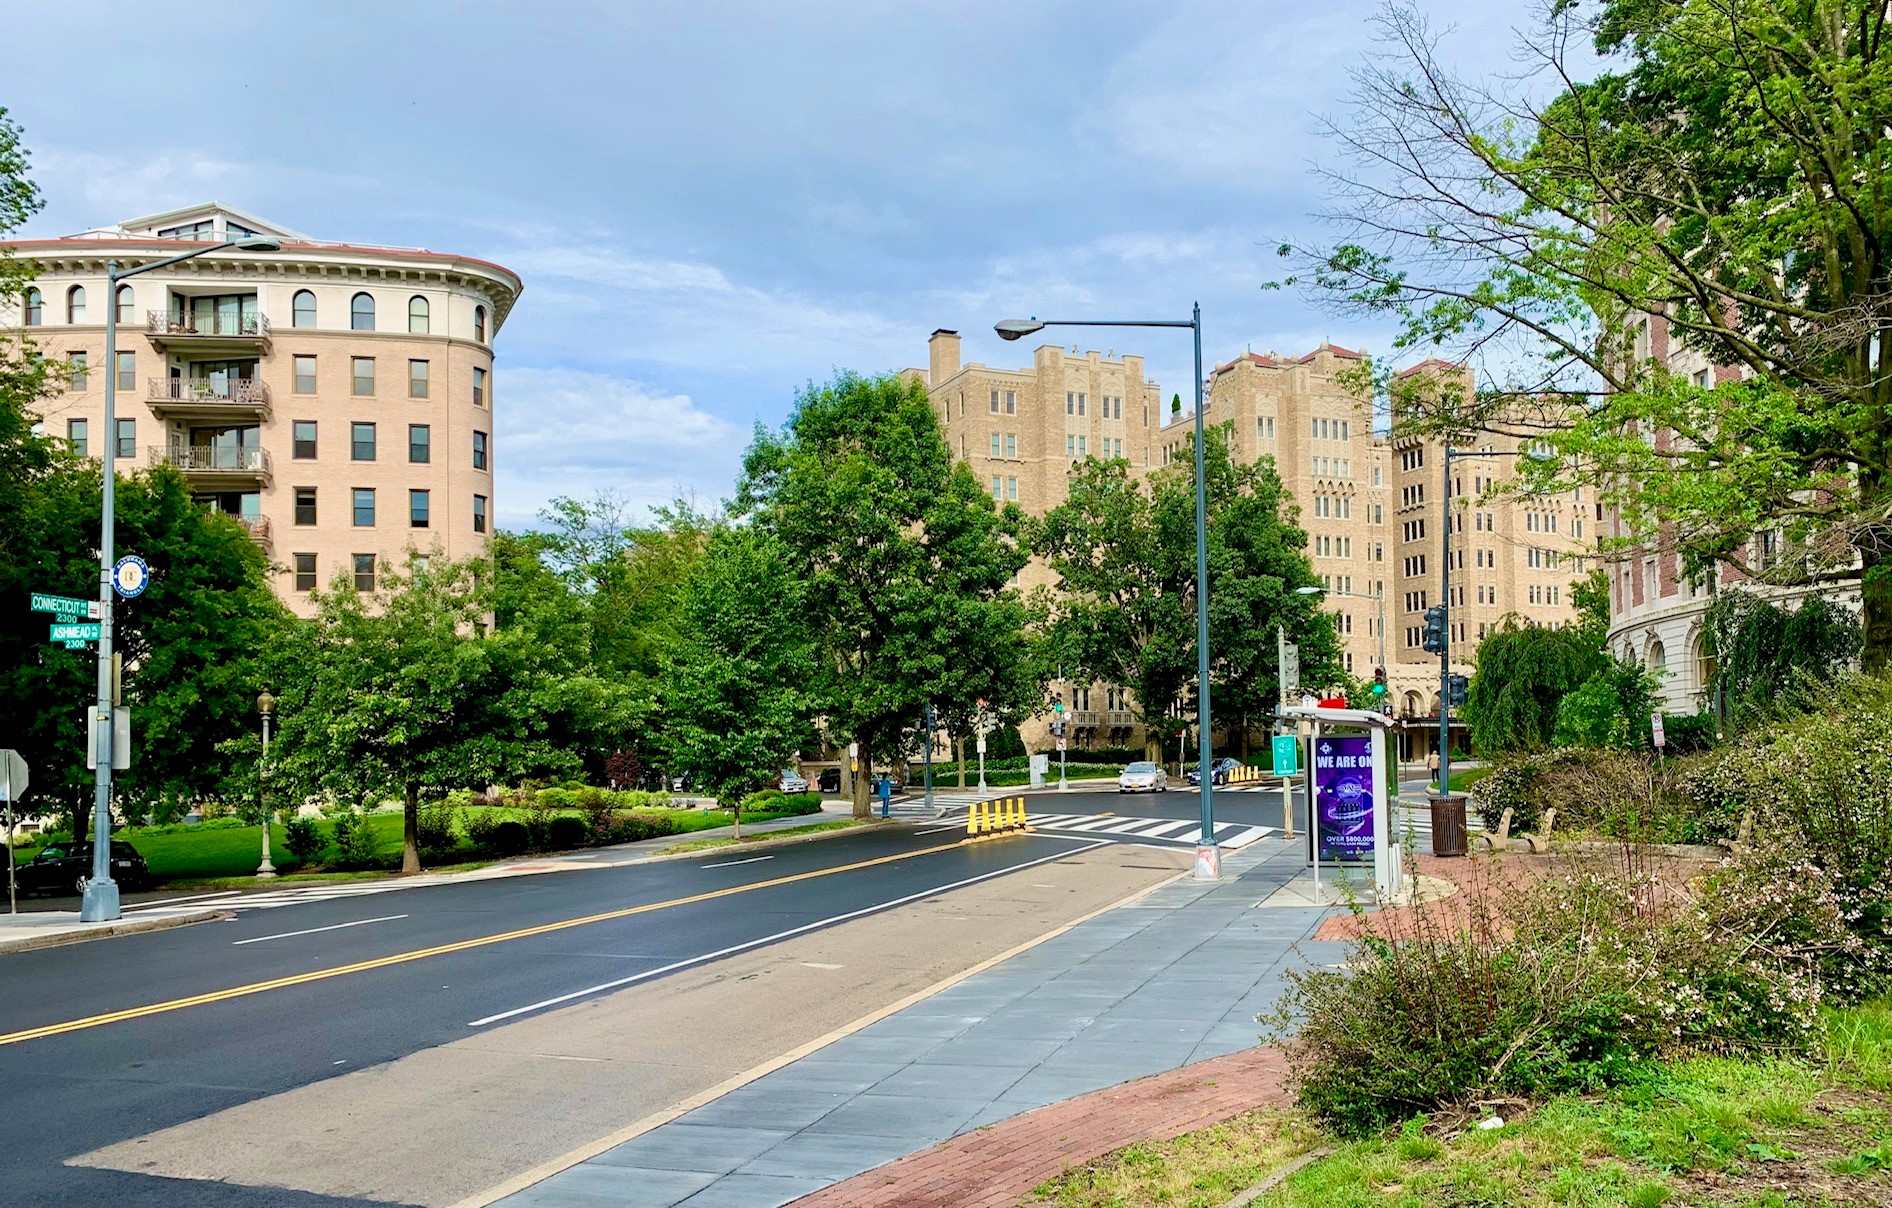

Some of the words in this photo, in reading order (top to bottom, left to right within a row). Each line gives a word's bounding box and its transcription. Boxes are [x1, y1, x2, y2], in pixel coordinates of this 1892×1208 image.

[124, 571, 137, 581] DC
[117, 585, 143, 595] TRIANGLE
[32, 596, 80, 614] CONNECTICUT
[57, 614, 78, 623] 2300
[53, 626, 91, 639] ASHMEAD
[65, 640, 85, 648] 2300
[1317, 756, 1334, 768] WE
[1336, 756, 1356, 768] ARE
